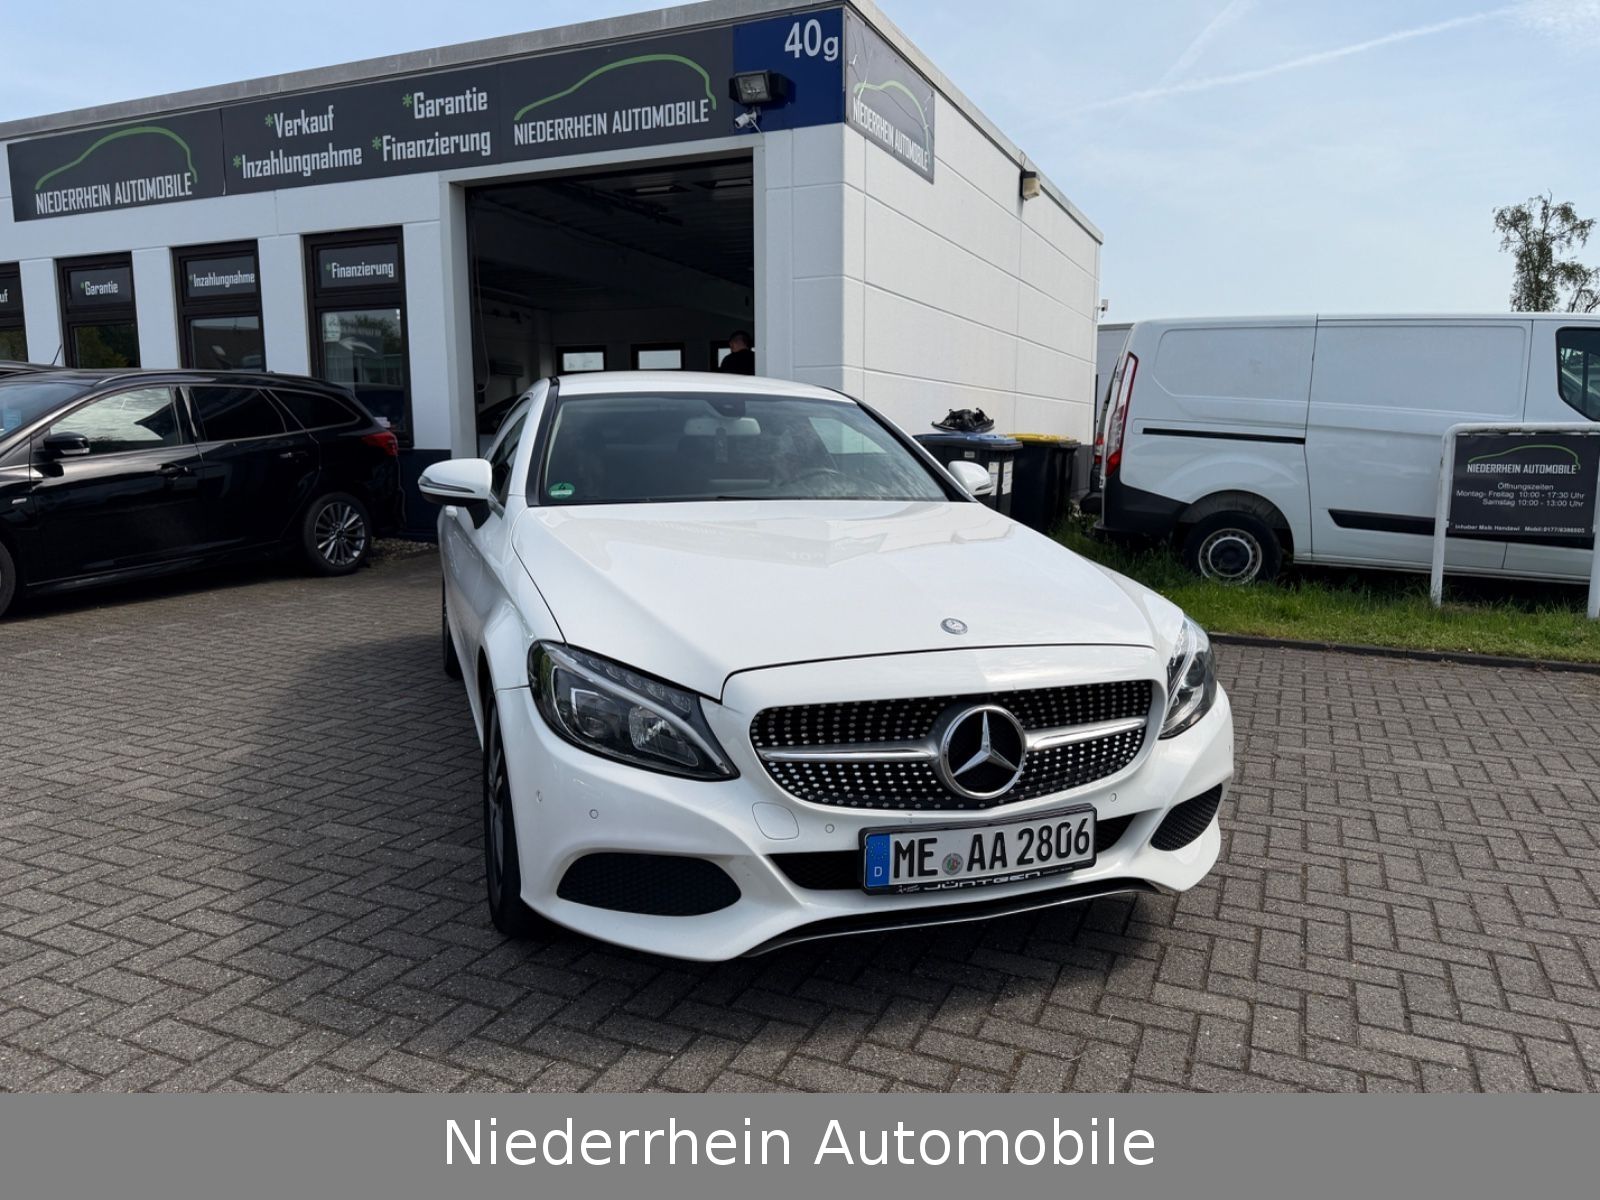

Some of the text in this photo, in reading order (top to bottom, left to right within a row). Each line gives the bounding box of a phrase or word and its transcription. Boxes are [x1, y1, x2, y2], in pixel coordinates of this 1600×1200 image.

[784, 19, 839, 61] 40g
[413, 87, 488, 120] Garantie
[273, 104, 335, 138] Verkauf
[513, 99, 710, 146] NIEDERRHEIN AUTOMOBILE
[853, 96, 928, 172] NIEDERRHEIN AUTOMOBILE
[242, 142, 363, 179] Inzahlungnahme
[382, 131, 491, 162] Finanzierung
[35, 172, 193, 215] NIEDERRHEIN AUTOMOBILE
[193, 271, 255, 288] Inzahlungnahme
[331, 261, 394, 279] Finanzierung
[84, 279, 119, 296] Garantie
[1467, 463, 1577, 475] NIEDERRHEIN AUTOMOBILE
[1482, 498, 1516, 507] Samstag
[1488, 490, 1515, 499] Freitag
[1547, 491, 1569, 499] 17:30
[893, 818, 1090, 879] ME AA 2806
[874, 866, 882, 877] D
